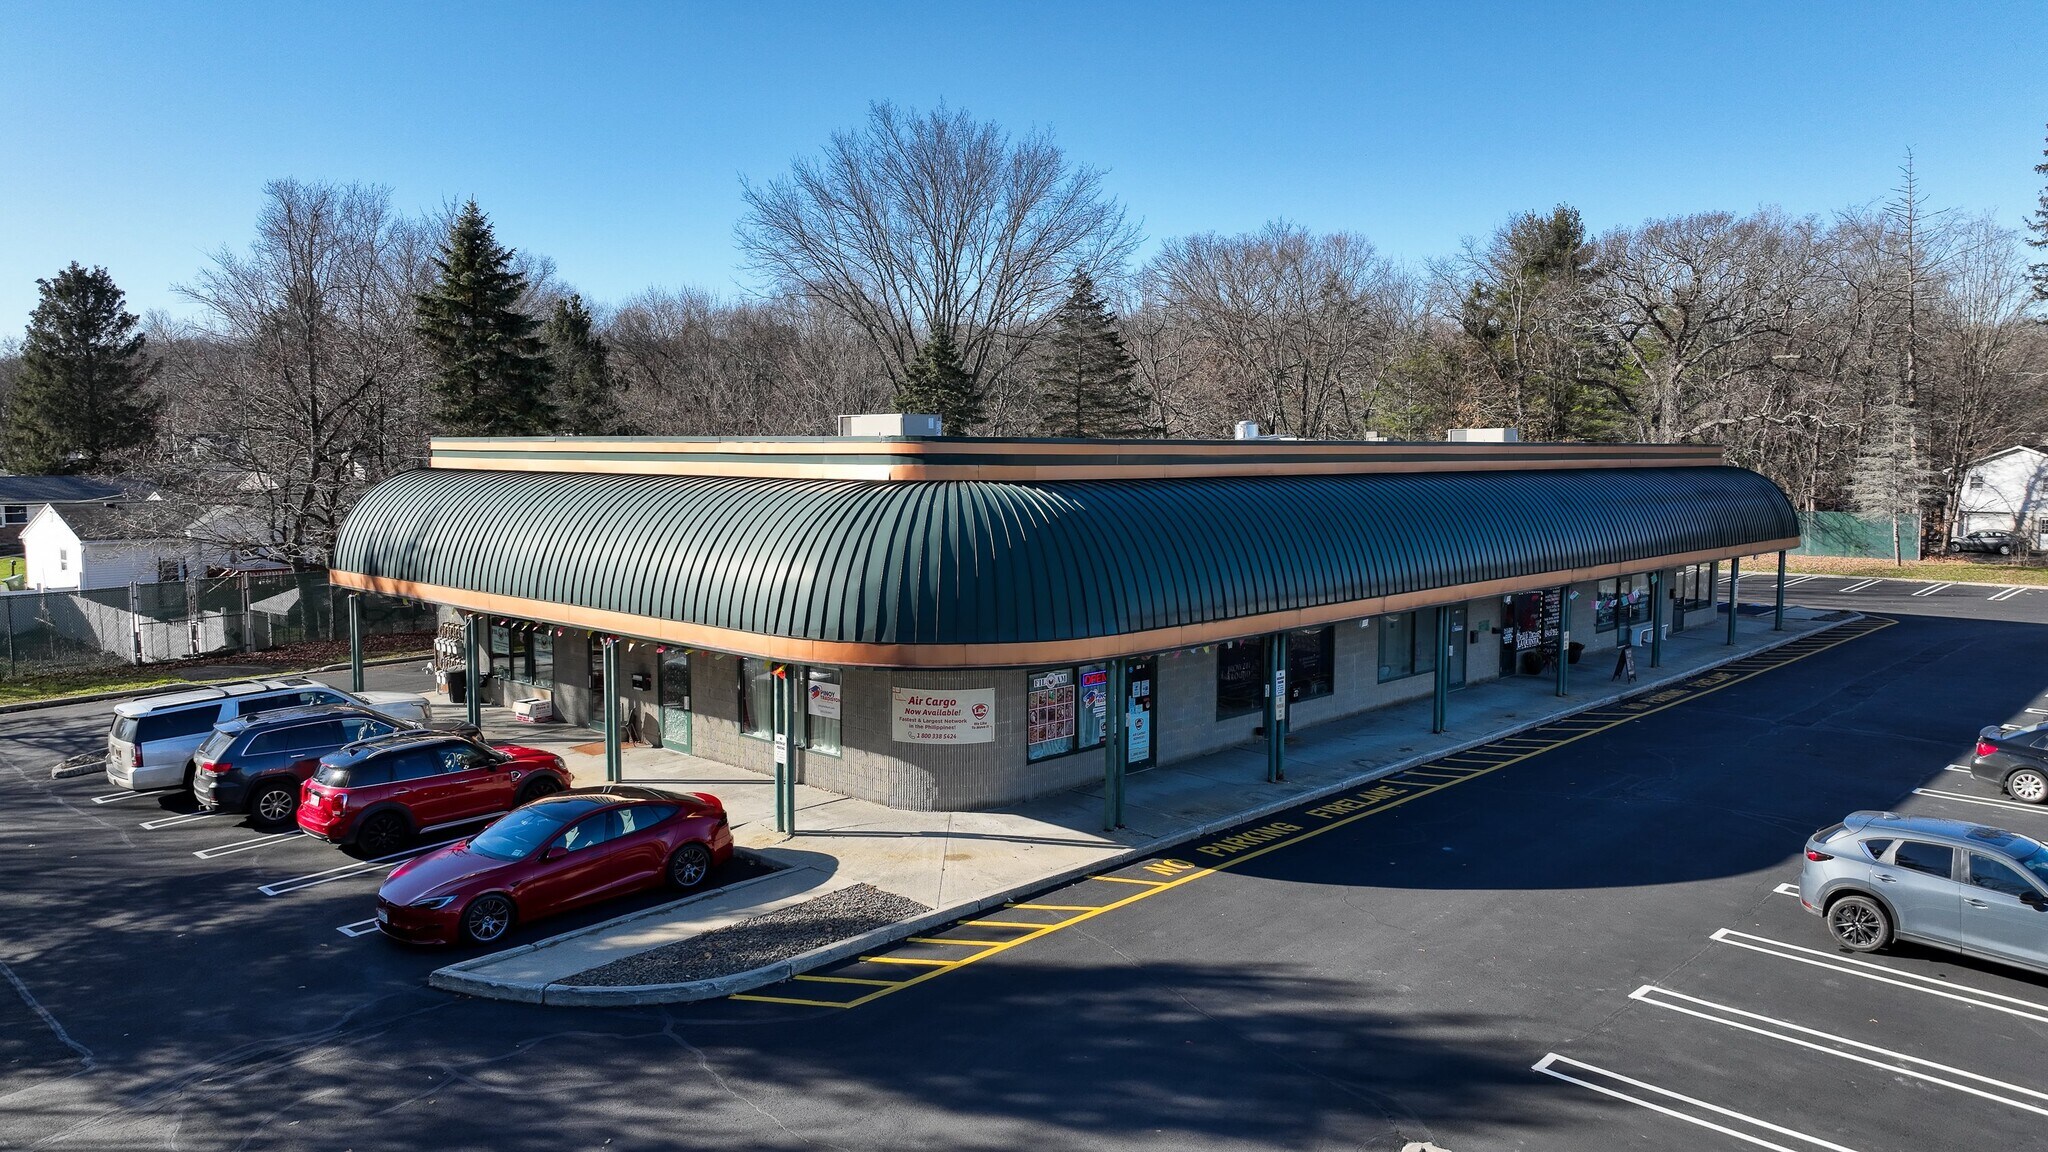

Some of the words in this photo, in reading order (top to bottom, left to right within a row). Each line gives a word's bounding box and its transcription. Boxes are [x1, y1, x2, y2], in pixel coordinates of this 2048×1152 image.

[908, 696, 923, 706] Air
[925, 697, 957, 708] Cargo
[922, 708, 962, 716] Available!
[1142, 858, 1196, 876] NO
[1196, 822, 1304, 857] PARKING
[1305, 785, 1408, 819] FIRELANE
